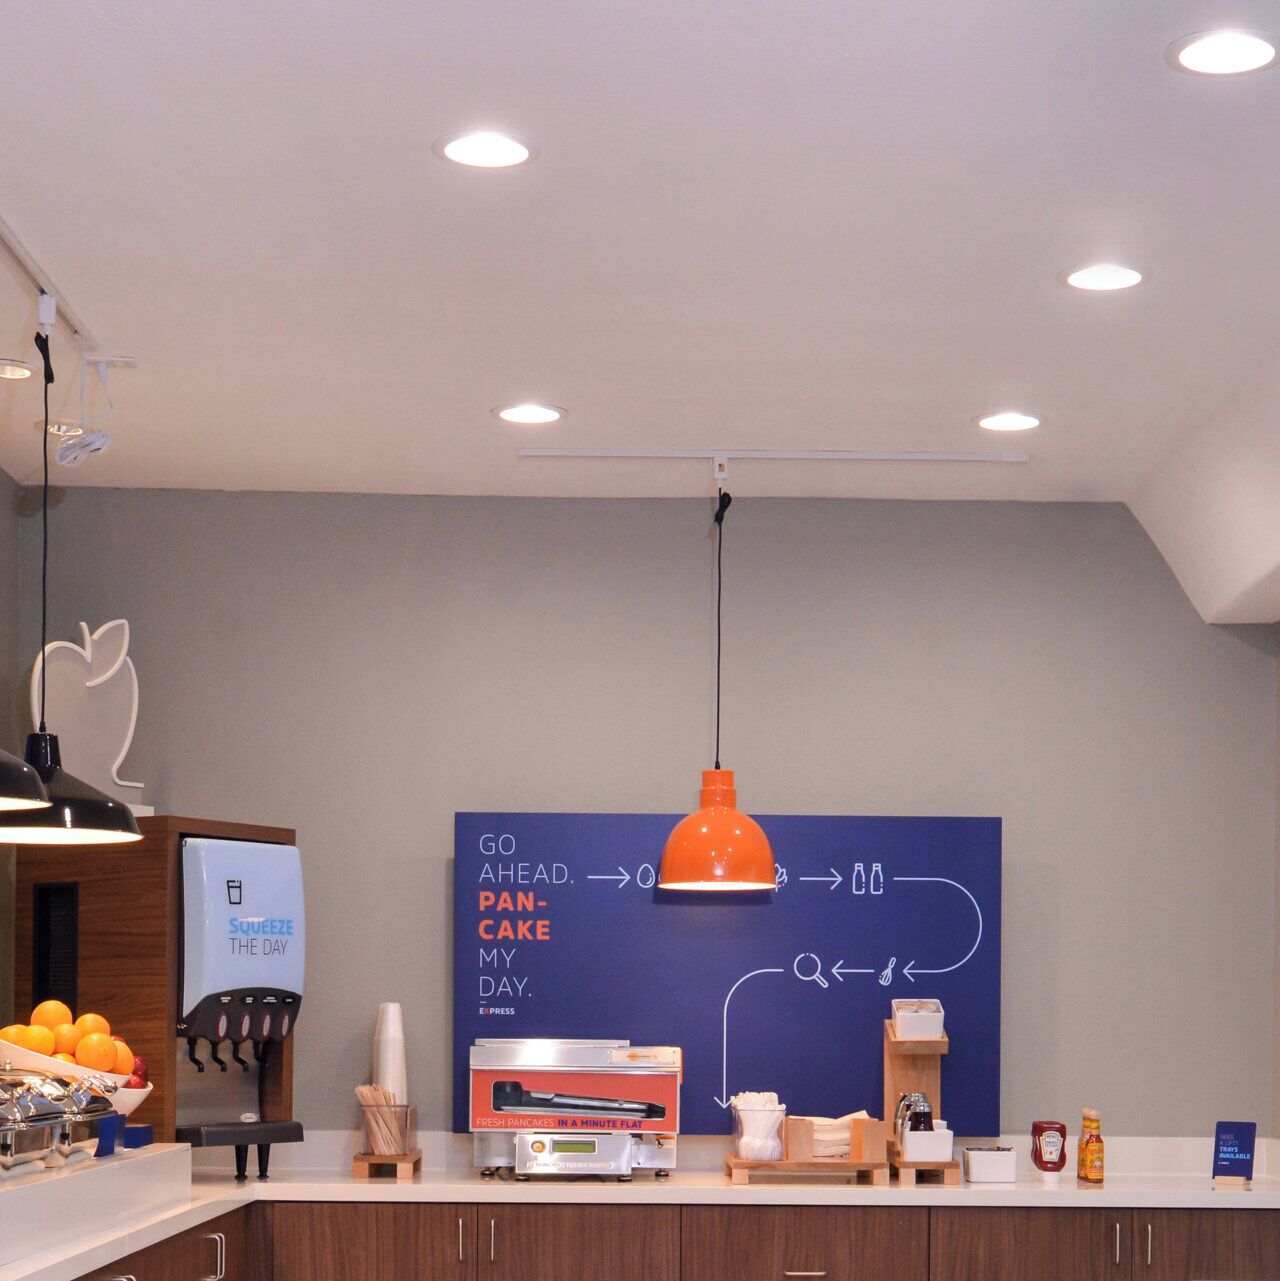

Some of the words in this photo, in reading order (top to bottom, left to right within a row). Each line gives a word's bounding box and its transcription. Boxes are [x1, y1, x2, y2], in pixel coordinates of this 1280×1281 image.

[479, 834, 516, 855] GO
[479, 863, 574, 884] AHEAD.
[479, 891, 547, 912] PAN-
[229, 917, 293, 936] SQUEEZE
[478, 919, 551, 941] CAKE
[229, 937, 258, 956] THE
[263, 938, 288, 956] DAY
[479, 948, 516, 968] MY
[479, 976, 532, 997] DAY.
[479, 1007, 515, 1015] EXPRESS
[476, 1117, 505, 1127] FRESH
[508, 1117, 554, 1127] PANCAKES
[557, 1119, 569, 1127] IN
[571, 1119, 578, 1127] A
[580, 1120, 618, 1128] MINUTE
[620, 1120, 643, 1129] FLAT
